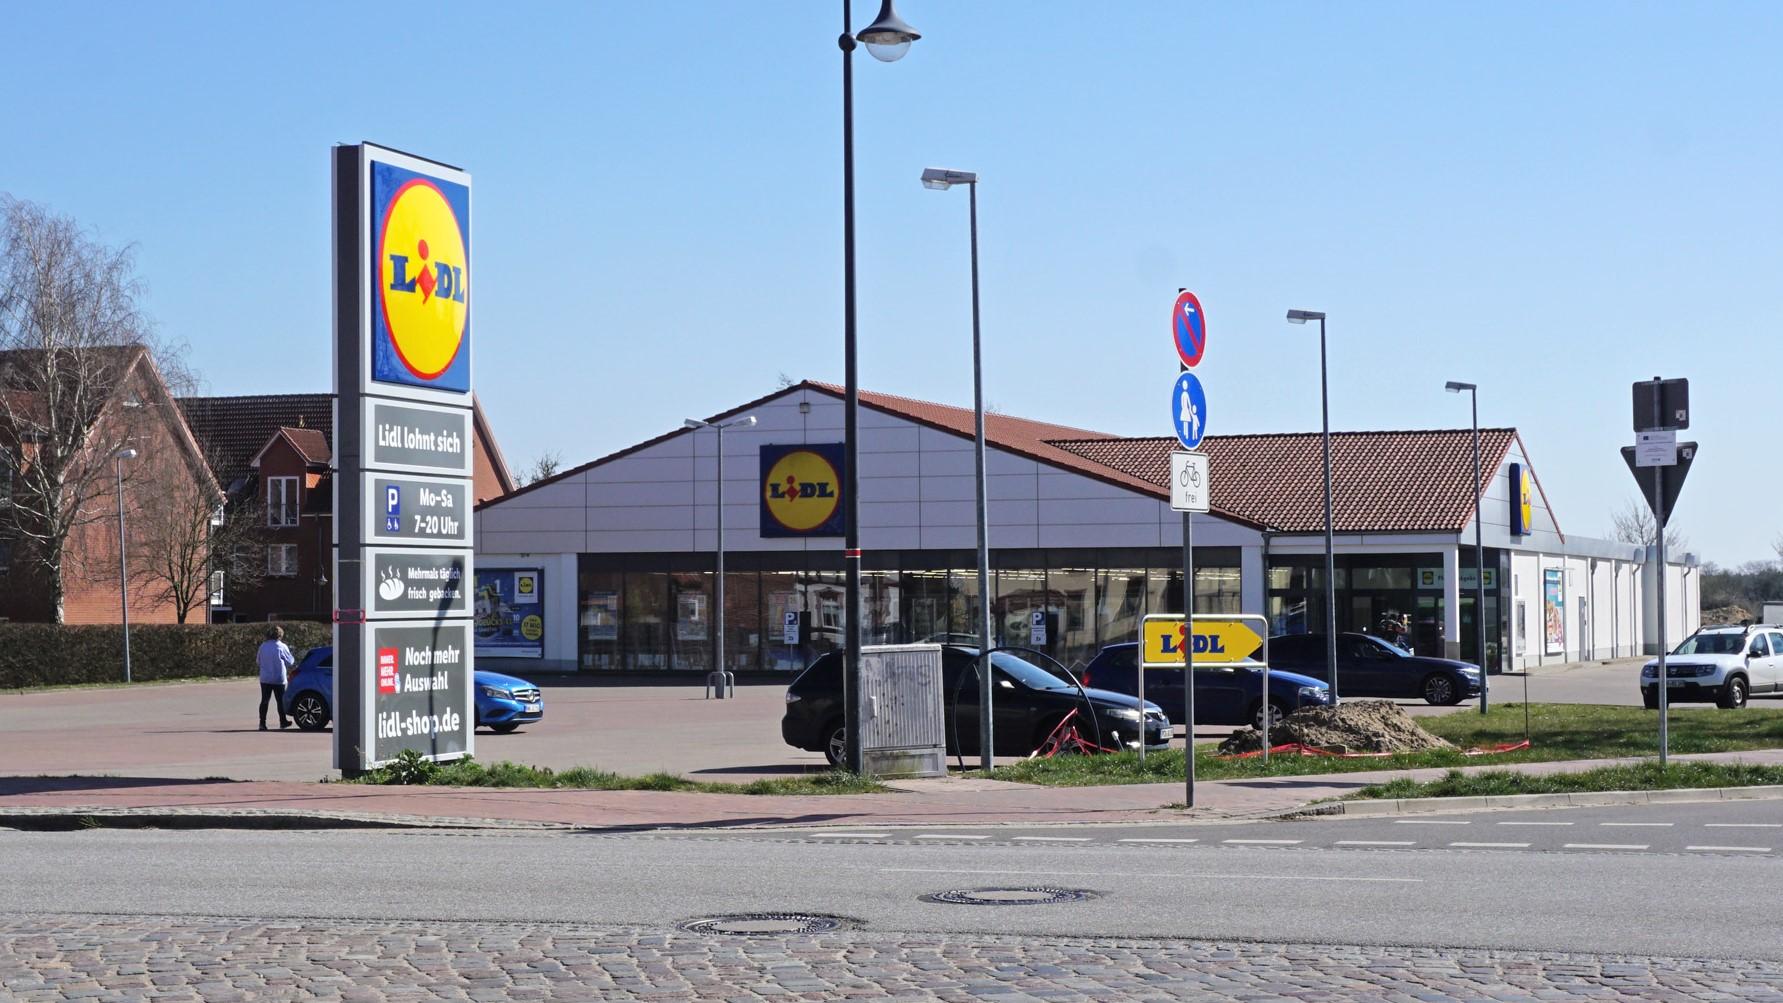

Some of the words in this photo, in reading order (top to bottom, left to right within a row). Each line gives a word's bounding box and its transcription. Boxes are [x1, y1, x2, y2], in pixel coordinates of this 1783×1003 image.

[389, 239, 465, 305] LIDL
[378, 424, 401, 448] Lidl
[404, 426, 435, 451] lohnt
[437, 430, 460, 453] sich
[419, 488, 453, 507] Mo-Sa
[769, 475, 834, 502] LIDL
[1185, 491, 1198, 504] frei
[387, 488, 398, 512] P
[414, 515, 438, 533] 7-20
[441, 516, 459, 535] Uhr
[408, 567, 438, 579] Mehrmals
[440, 567, 460, 582] täglich
[408, 586, 427, 599] frisch
[405, 646, 432, 666] Noch
[433, 645, 460, 664] mehr
[404, 670, 448, 693] Auswahl
[378, 706, 460, 739] lidl-shop.de
